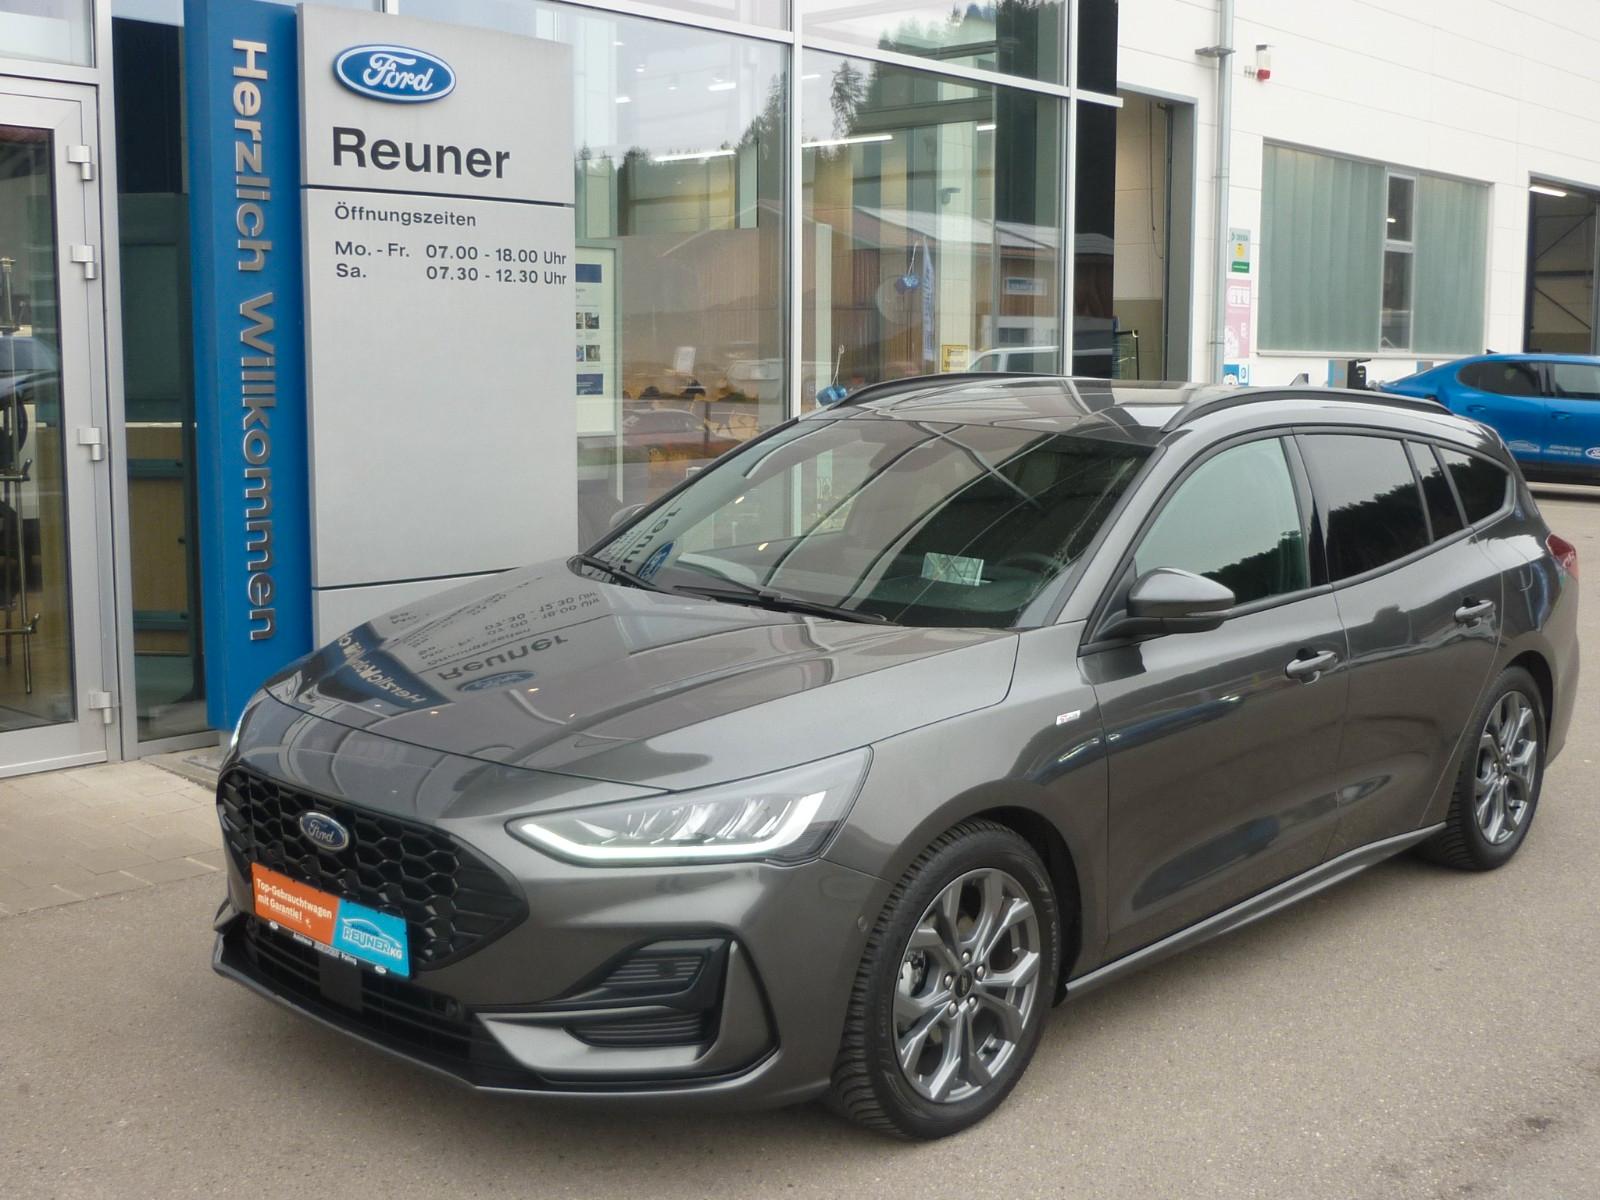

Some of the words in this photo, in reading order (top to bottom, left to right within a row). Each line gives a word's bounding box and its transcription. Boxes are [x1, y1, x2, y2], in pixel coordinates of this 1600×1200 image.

[362, 53, 434, 92] Ford
[232, 39, 273, 272] Herzlich
[332, 126, 510, 179] Reuner
[334, 202, 477, 227] Öffnungszeiten
[335, 241, 372, 257] Mo.
[387, 243, 410, 258] Fr.
[426, 244, 478, 260] 07.00
[496, 248, 538, 264] 18.00
[543, 250, 567, 265] Uhr
[336, 263, 367, 278] Sa.
[426, 266, 478, 282] 07.30
[496, 269, 538, 284] 12.30
[543, 271, 567, 286] Uhr
[239, 292, 277, 641] Willkommen
[257, 894, 269, 907] mit
[342, 926, 390, 953] REUNER
